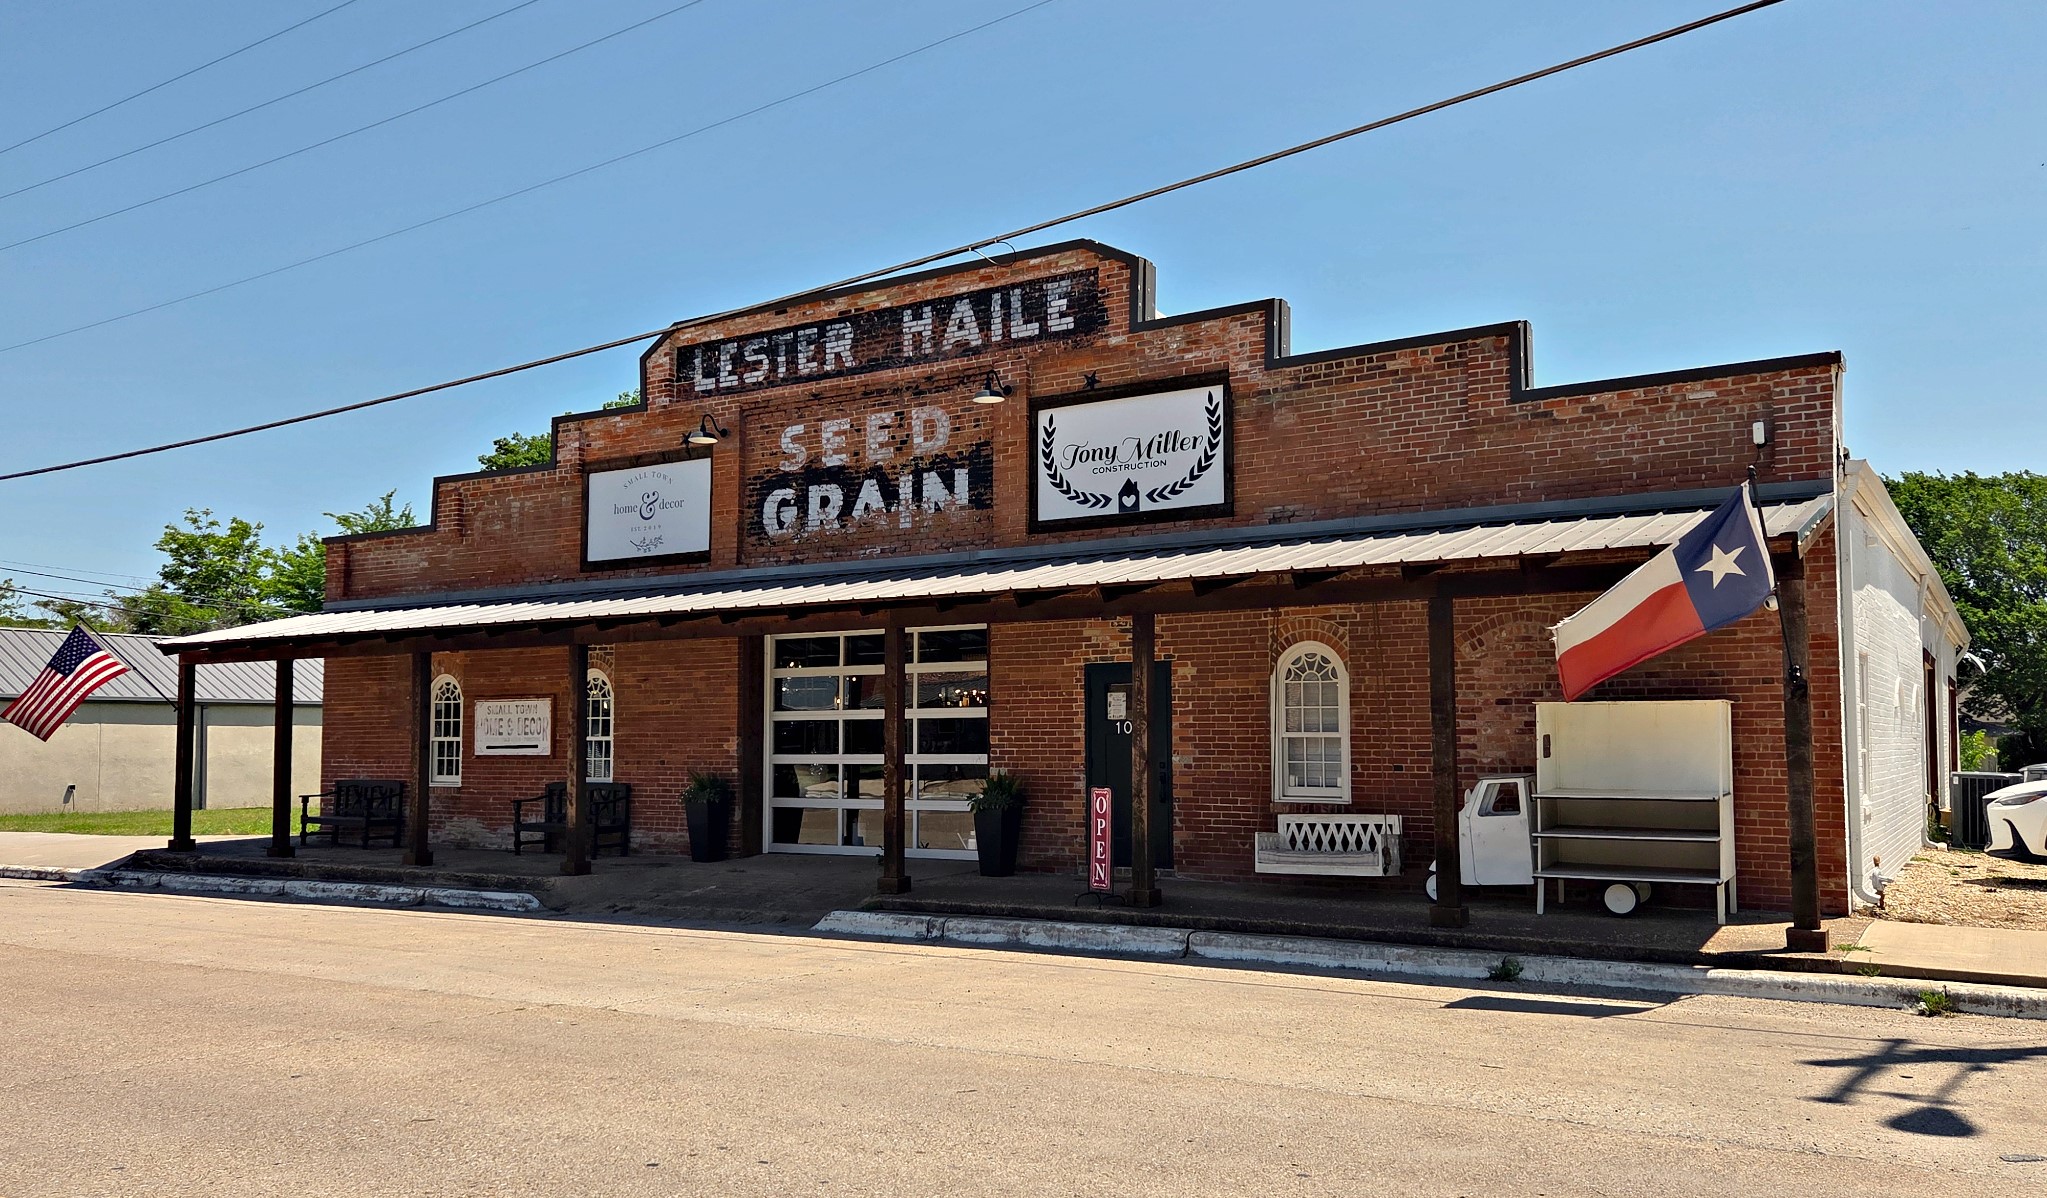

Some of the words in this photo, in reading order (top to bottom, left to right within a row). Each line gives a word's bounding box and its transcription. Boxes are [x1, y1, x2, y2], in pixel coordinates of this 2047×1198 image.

[692, 321, 857, 393] LESTER
[902, 279, 1076, 358] HAILE
[779, 406, 952, 472] SEED
[1060, 440, 1118, 471] Tony
[1117, 429, 1204, 463] Miller
[623, 472, 648, 489] SMALL
[652, 471, 673, 485] TOWN
[1092, 459, 1167, 475] CONSTRUCTION
[613, 503, 638, 515] home
[639, 490, 660, 521] &
[659, 498, 685, 510] decor
[762, 467, 970, 540] GRAIN
[517, 717, 549, 741] DECOR
[1095, 796, 1107, 881] OPEN
